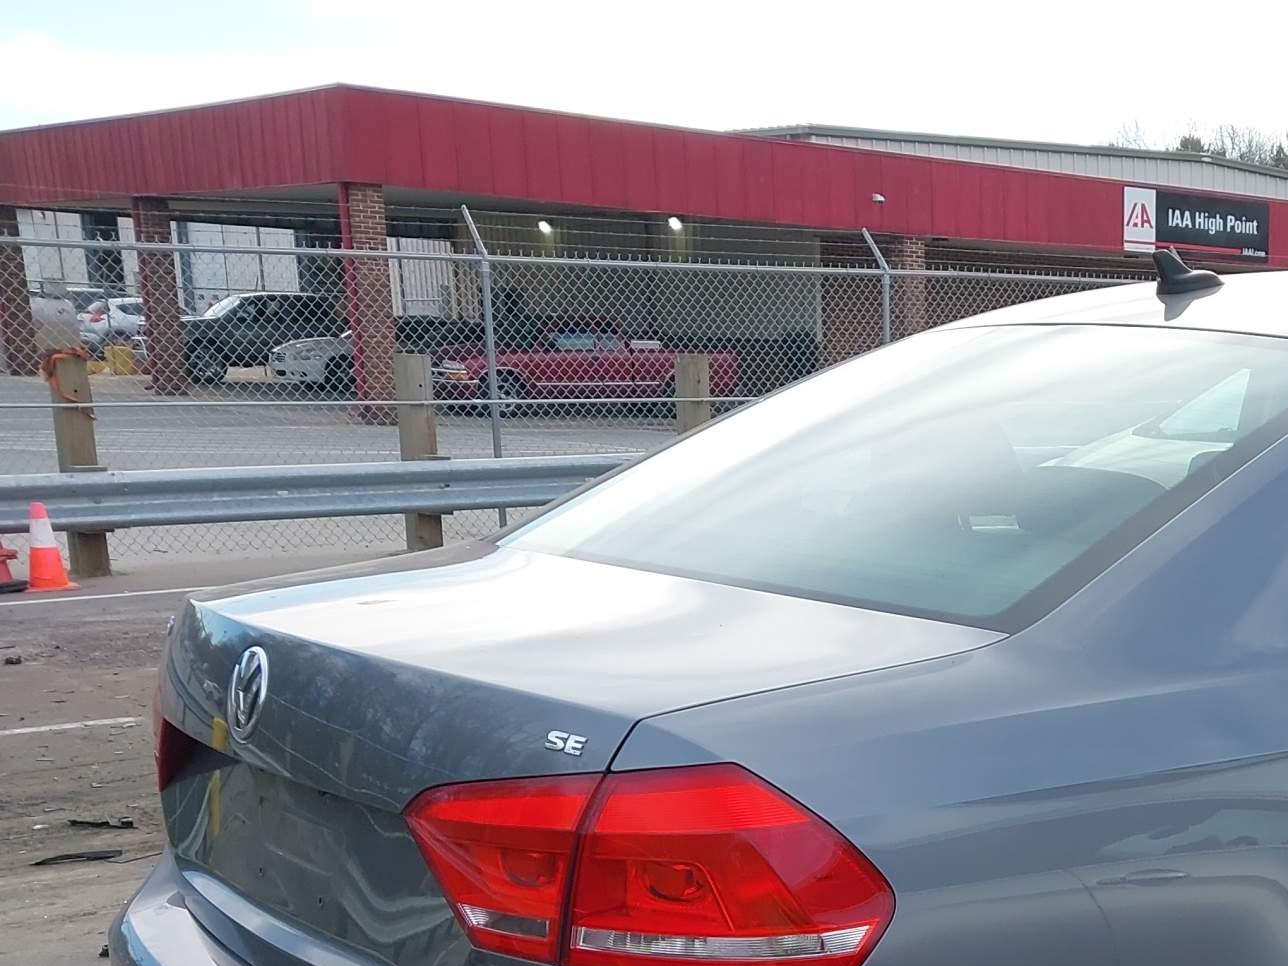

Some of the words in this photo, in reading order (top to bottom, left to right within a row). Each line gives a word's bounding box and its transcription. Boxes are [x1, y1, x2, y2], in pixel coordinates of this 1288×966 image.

[1168, 208, 1193, 229] IAA
[1195, 211, 1224, 235] High
[1226, 215, 1258, 235] Point
[544, 729, 589, 757] SE
